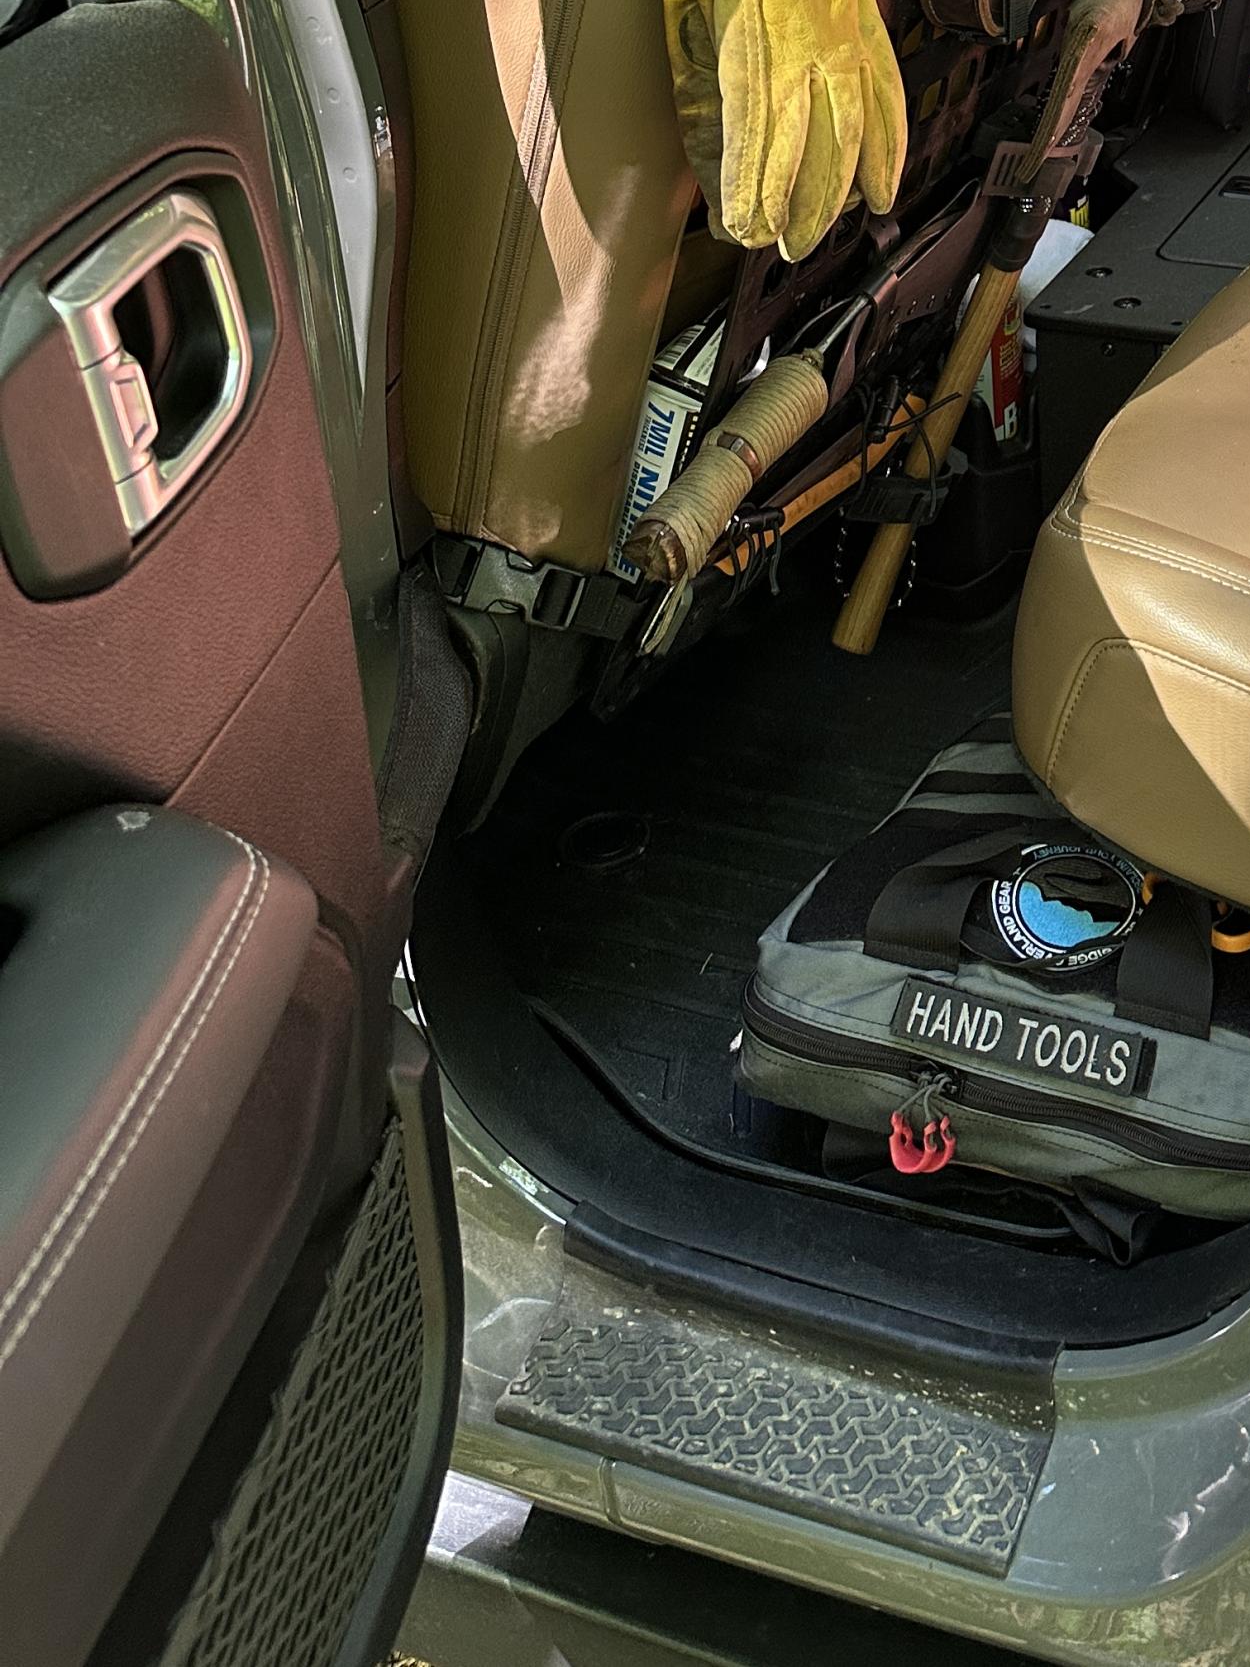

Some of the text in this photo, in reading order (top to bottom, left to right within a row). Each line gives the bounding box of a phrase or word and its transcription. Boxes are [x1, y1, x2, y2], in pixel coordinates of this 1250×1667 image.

[622, 460, 641, 526] DISPOSABLE
[998, 881, 1013, 914] GEAR
[906, 992, 1131, 1086] HAND TOOLS
